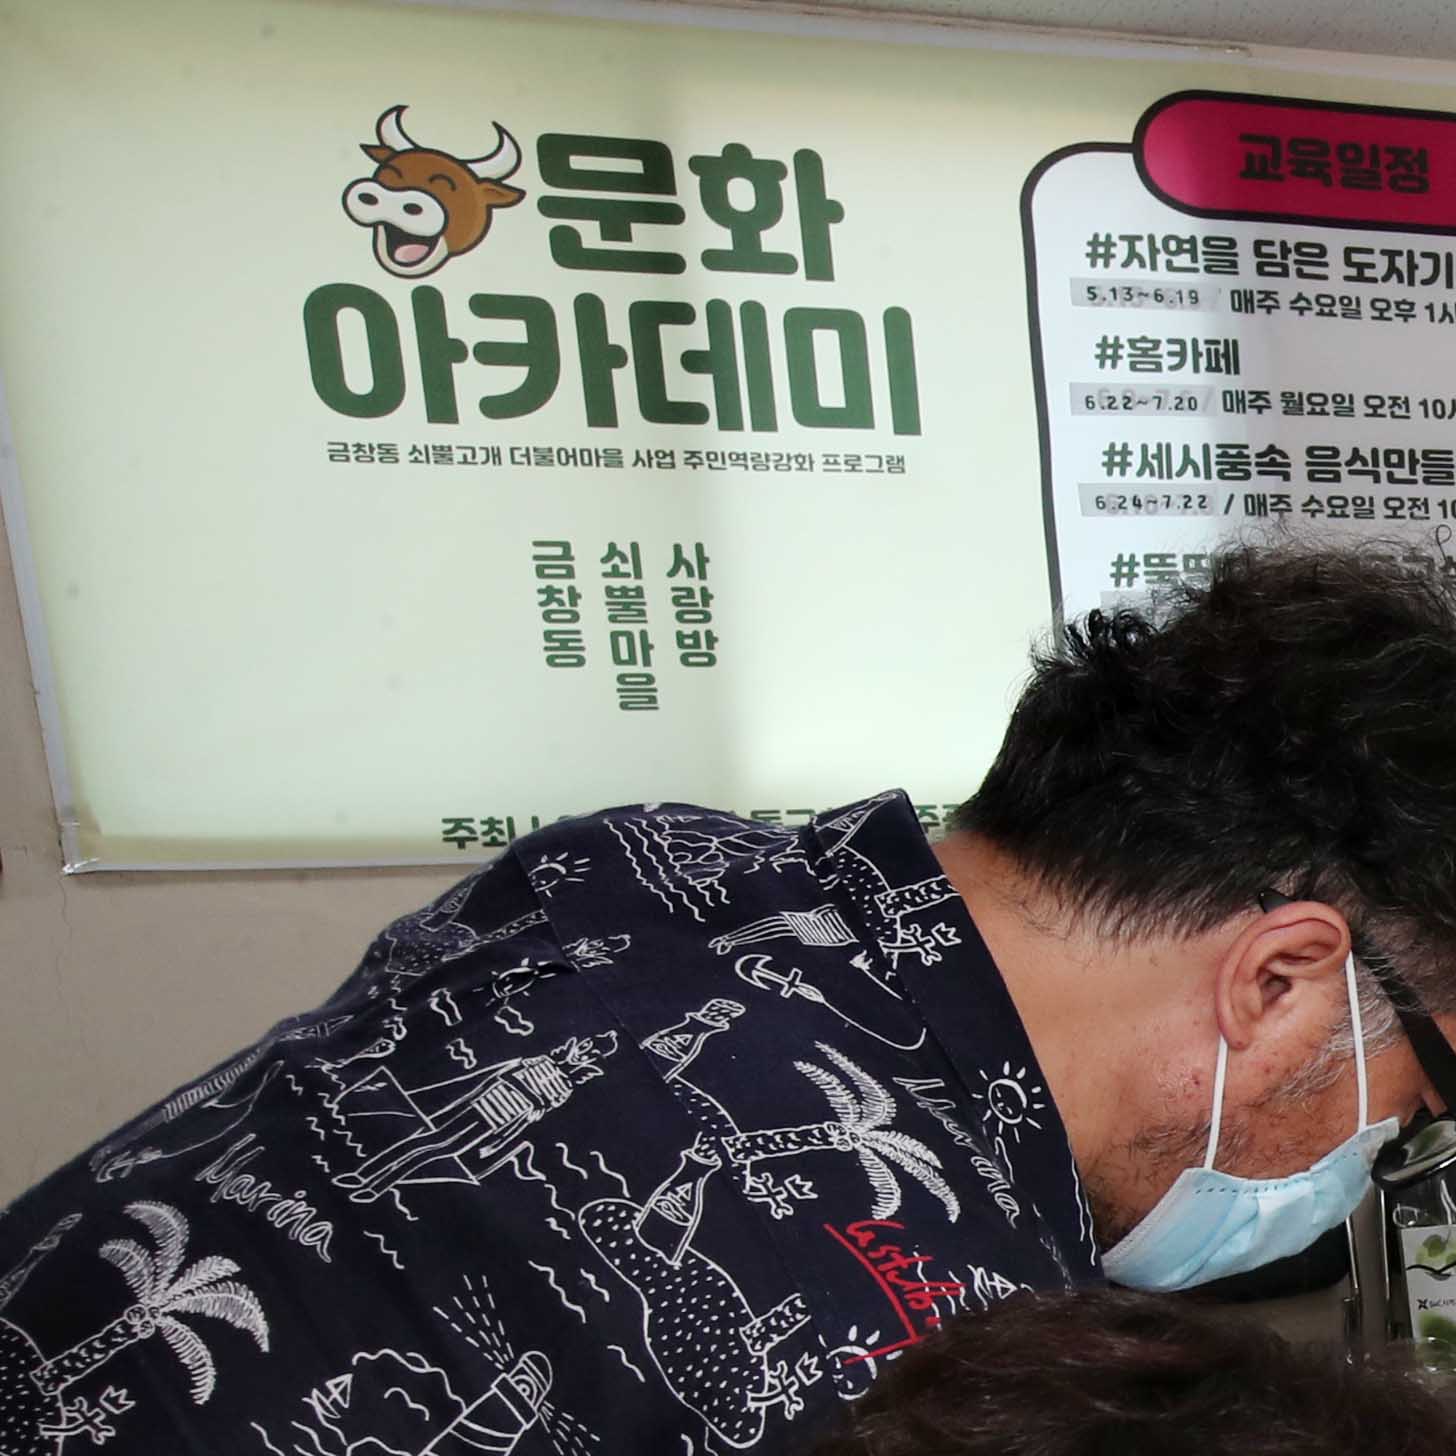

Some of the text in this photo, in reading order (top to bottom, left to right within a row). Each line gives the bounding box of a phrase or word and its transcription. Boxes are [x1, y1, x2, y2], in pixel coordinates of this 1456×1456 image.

[1238, 134, 1431, 194] 교육일정
[536, 131, 845, 281] 문화
[1085, 233, 1454, 289] #자연을 담은 도자기
[1230, 288, 1280, 315] 매주
[1289, 291, 1362, 321] 수요일
[1370, 298, 1416, 324] 오후
[302, 283, 923, 436] 아카데미
[1094, 335, 1241, 376] #홈카페
[1222, 389, 1272, 416] 매주
[1280, 391, 1355, 419] 월요일
[1363, 395, 1412, 420] 오전
[326, 441, 906, 476] 금창동 쇠뿔고개 더불어마을 사업 주민역량강화 프로그램
[1101, 441, 1292, 482] #세시풍속
[1243, 493, 1294, 518] 매주
[1300, 494, 1376, 520] 수요일
[1383, 495, 1431, 521] 오전
[532, 540, 586, 669] 금창동
[600, 541, 660, 712] 쇠뿔마을
[666, 542, 718, 668] 사랑방
[442, 816, 516, 849] 주최
[195, 1134, 332, 1263] Marina
